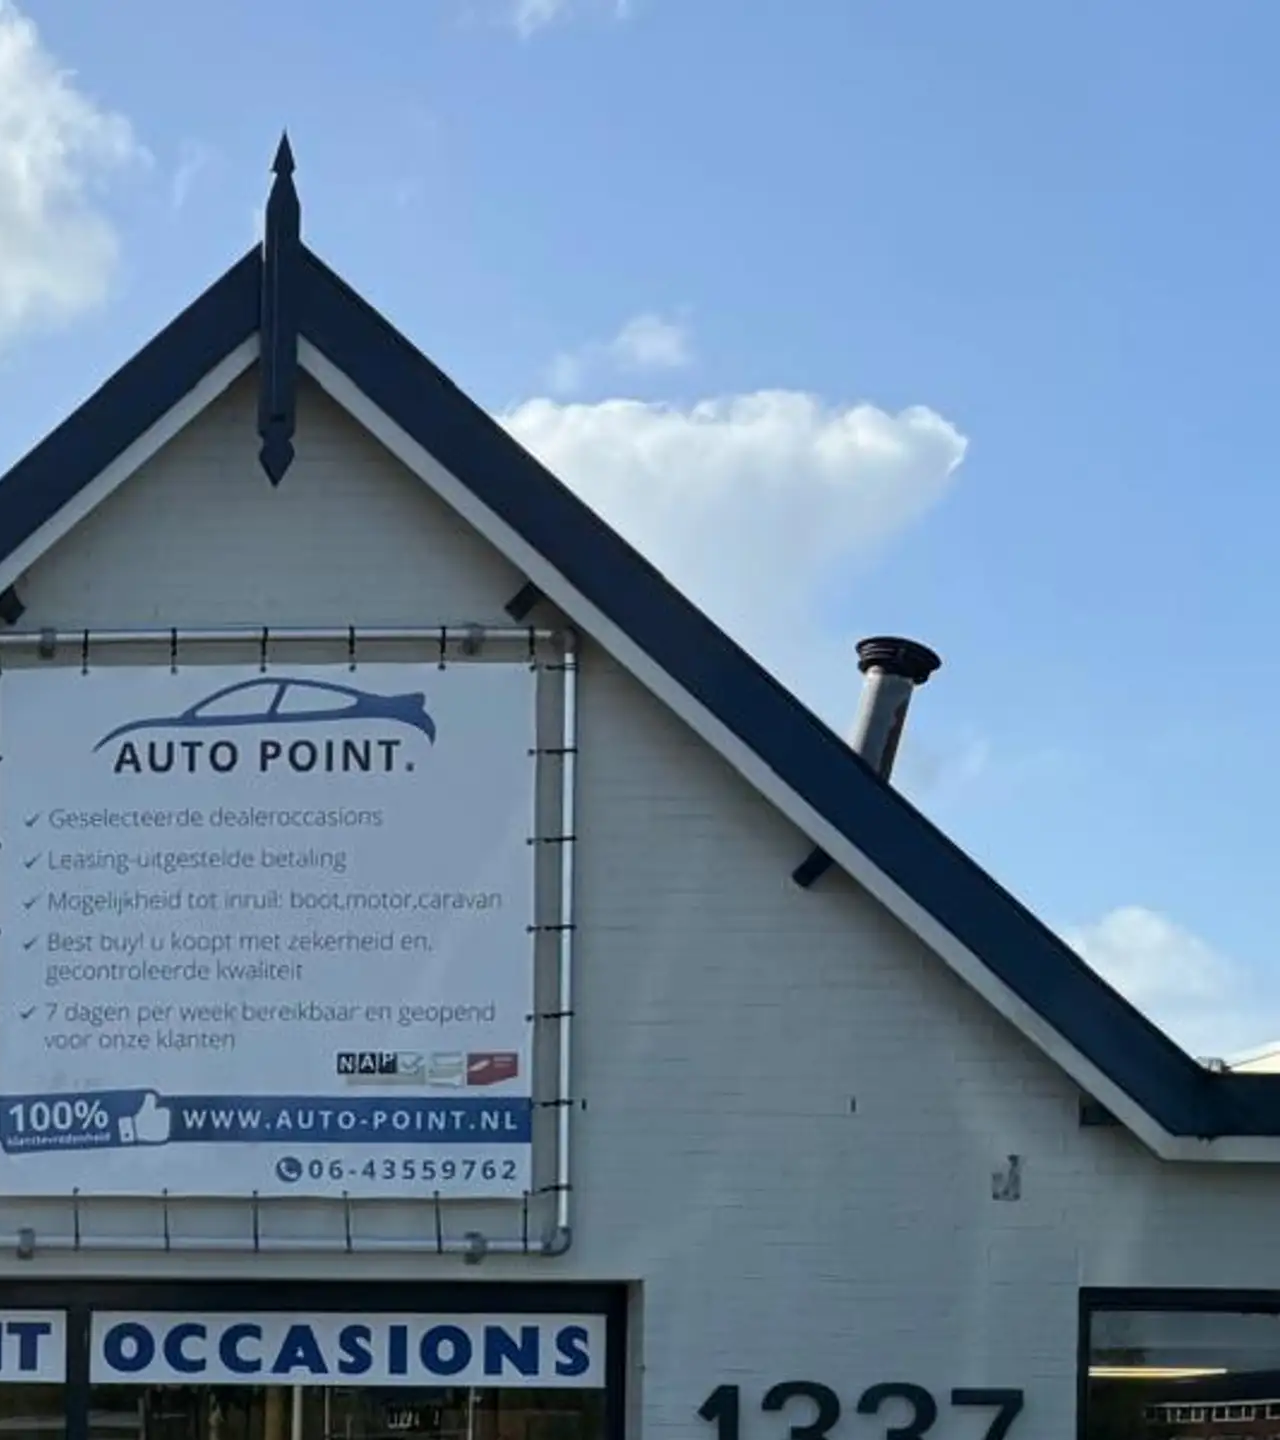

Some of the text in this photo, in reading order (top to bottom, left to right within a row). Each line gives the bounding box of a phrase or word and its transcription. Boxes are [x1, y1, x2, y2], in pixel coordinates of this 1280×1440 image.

[113, 738, 416, 774] AUTO POINT.
[47, 805, 385, 830] Geselecteerde dealeroccasions
[46, 849, 348, 876] Leasing-uitgestelde betaling
[46, 889, 183, 917] Mogelijkheid
[187, 892, 219, 911] tot
[46, 932, 94, 952] Best
[98, 931, 144, 956] buy!
[149, 935, 165, 952] u
[169, 931, 232, 955] koopt
[239, 934, 281, 953] met
[287, 931, 394, 953] zekerheid
[43, 959, 303, 987] gecontroleerde kwaliteit
[43, 1001, 496, 1028] 7 dagen per week bereikbaar en geopend
[43, 1028, 236, 1052] voor onze klanten
[337, 1052, 398, 1074] NAP
[8, 1099, 110, 1133] 100%
[182, 1109, 519, 1131] WWW.AUTO-POINT.NL
[307, 1158, 518, 1181] 06-43559762
[104, 1321, 593, 1379] OCCASIONS
